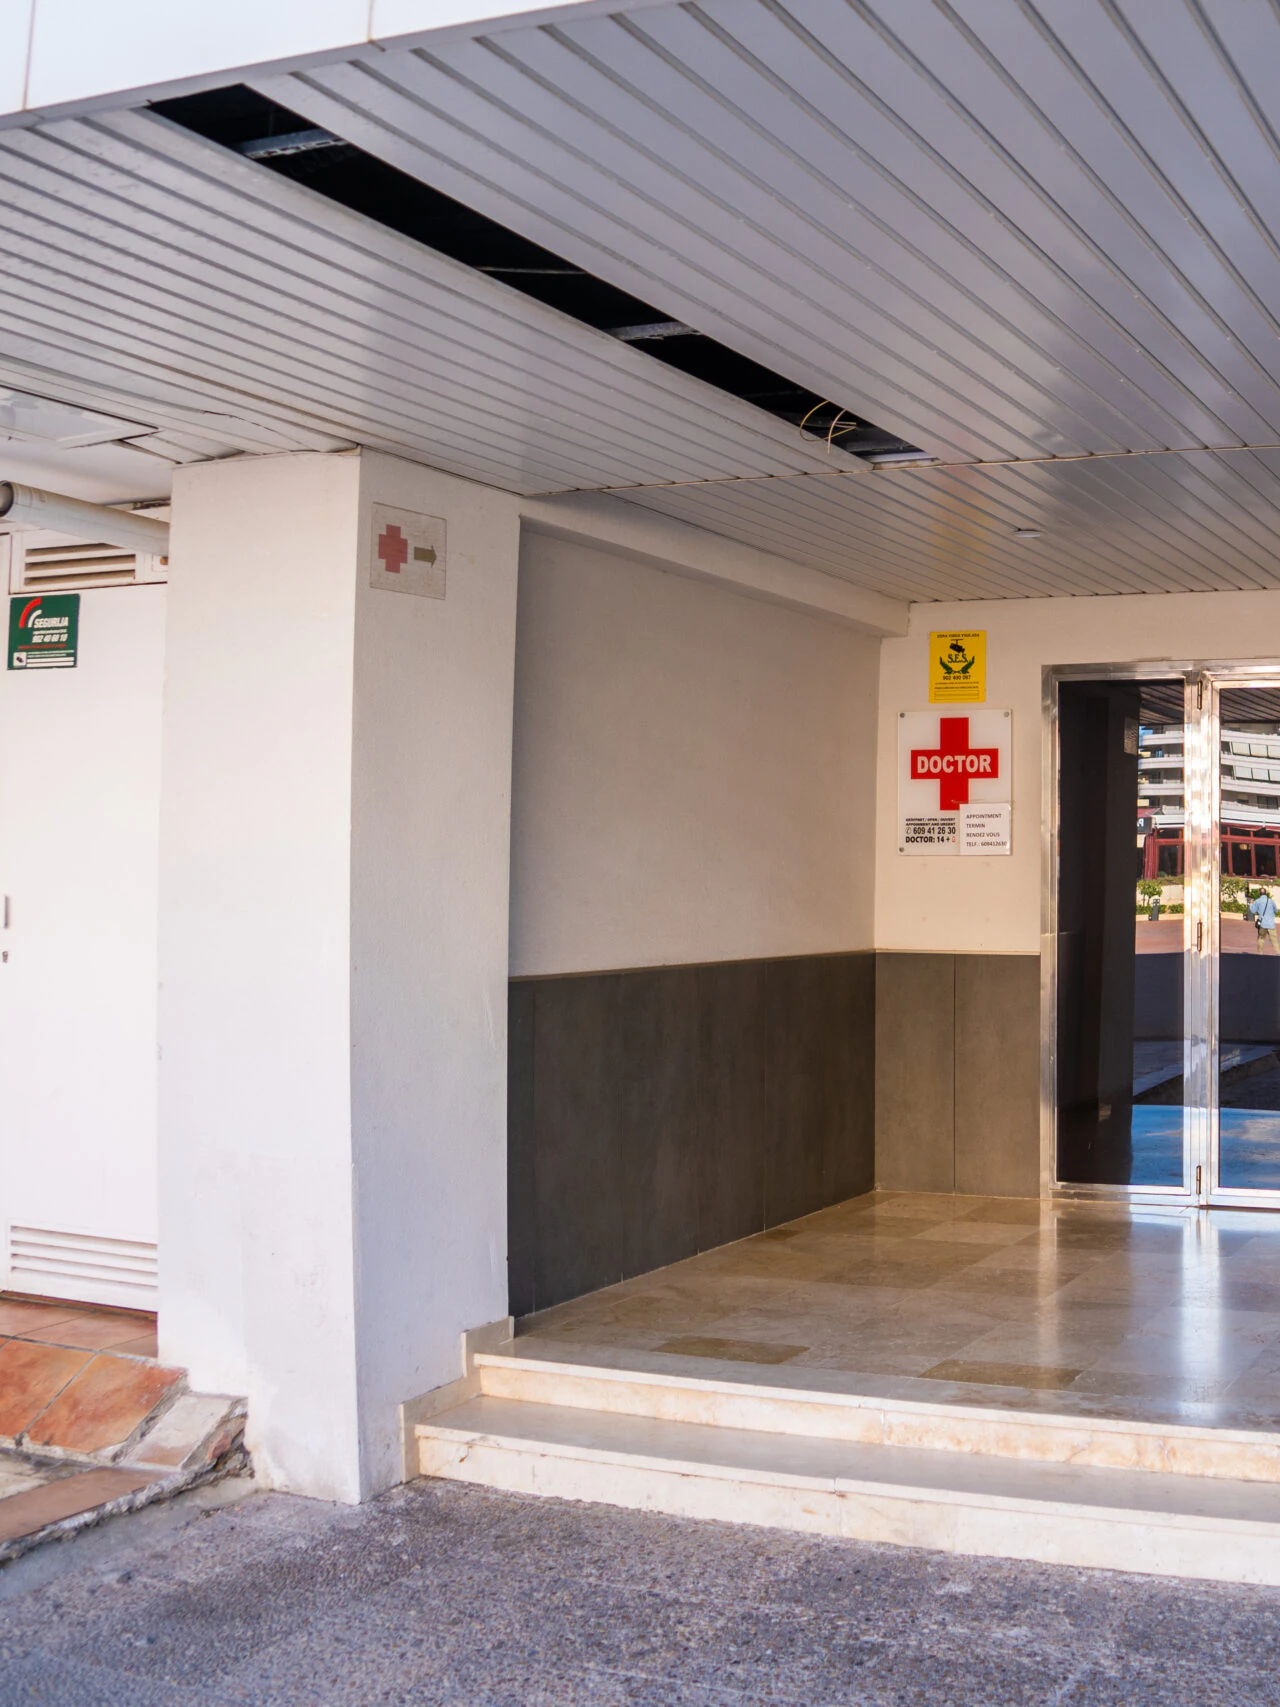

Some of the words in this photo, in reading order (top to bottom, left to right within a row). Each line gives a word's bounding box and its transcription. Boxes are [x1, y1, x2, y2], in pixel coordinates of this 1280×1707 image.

[917, 754, 992, 774] DOCTOR
[913, 826, 926, 834] 609
[927, 826, 935, 834] 41
